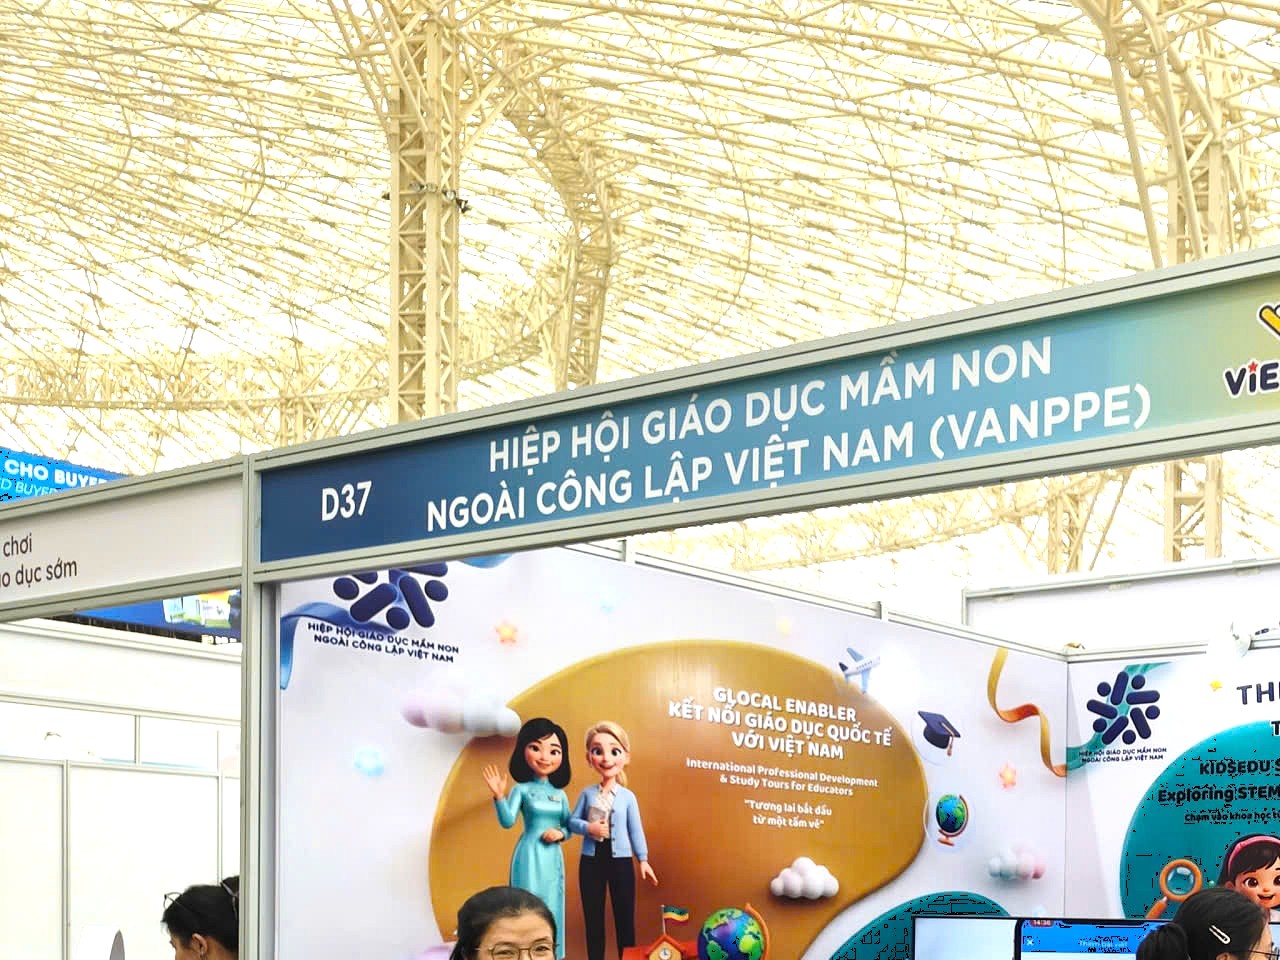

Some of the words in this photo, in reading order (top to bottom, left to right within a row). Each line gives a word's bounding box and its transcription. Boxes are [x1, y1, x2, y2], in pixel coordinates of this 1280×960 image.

[489, 424, 560, 478] HIỆP
[571, 409, 629, 463] HỘI
[642, 393, 732, 446] GIÁO
[746, 380, 825, 431] DỤC
[840, 351, 935, 411] MẦM
[952, 335, 1051, 390] NON
[5, 459, 49, 481] CHO
[427, 478, 525, 533] NGOÀI
[536, 465, 632, 515] CÔNG
[644, 451, 713, 504] LẬP
[725, 434, 809, 488] VIỆT
[823, 421, 913, 472] NAM
[929, 383, 1151, 460] (VANPPE)
[321, 480, 373, 521] D37
[3, 532, 33, 557] chơi
[15, 563, 42, 588] dục
[46, 556, 78, 581] sớm
[432, 653, 454, 663] NAM
[437, 643, 460, 654] NON
[713, 687, 782, 711] GLOCAL
[785, 697, 857, 722] ENABLER
[668, 695, 704, 721] KẾT
[745, 711, 787, 733] GIÁO
[791, 718, 824, 740] DỤC
[827, 720, 872, 745] QUỐC
[874, 725, 893, 747] TẾ
[732, 729, 765, 750] VỚI
[768, 735, 805, 758] VIỆT
[808, 742, 844, 760] NAM
[686, 757, 756, 774] International
[757, 765, 818, 782] Professional
[819, 772, 879, 789] Development
[1199, 759, 1271, 775] KIDSEDU
[720, 774, 728, 784] &
[730, 775, 760, 789] Study
[762, 778, 790, 790] Tours
[791, 782, 806, 791] for
[807, 783, 854, 797] Educators
[1158, 785, 1237, 804] Exploring
[784, 801, 796, 812] lai
